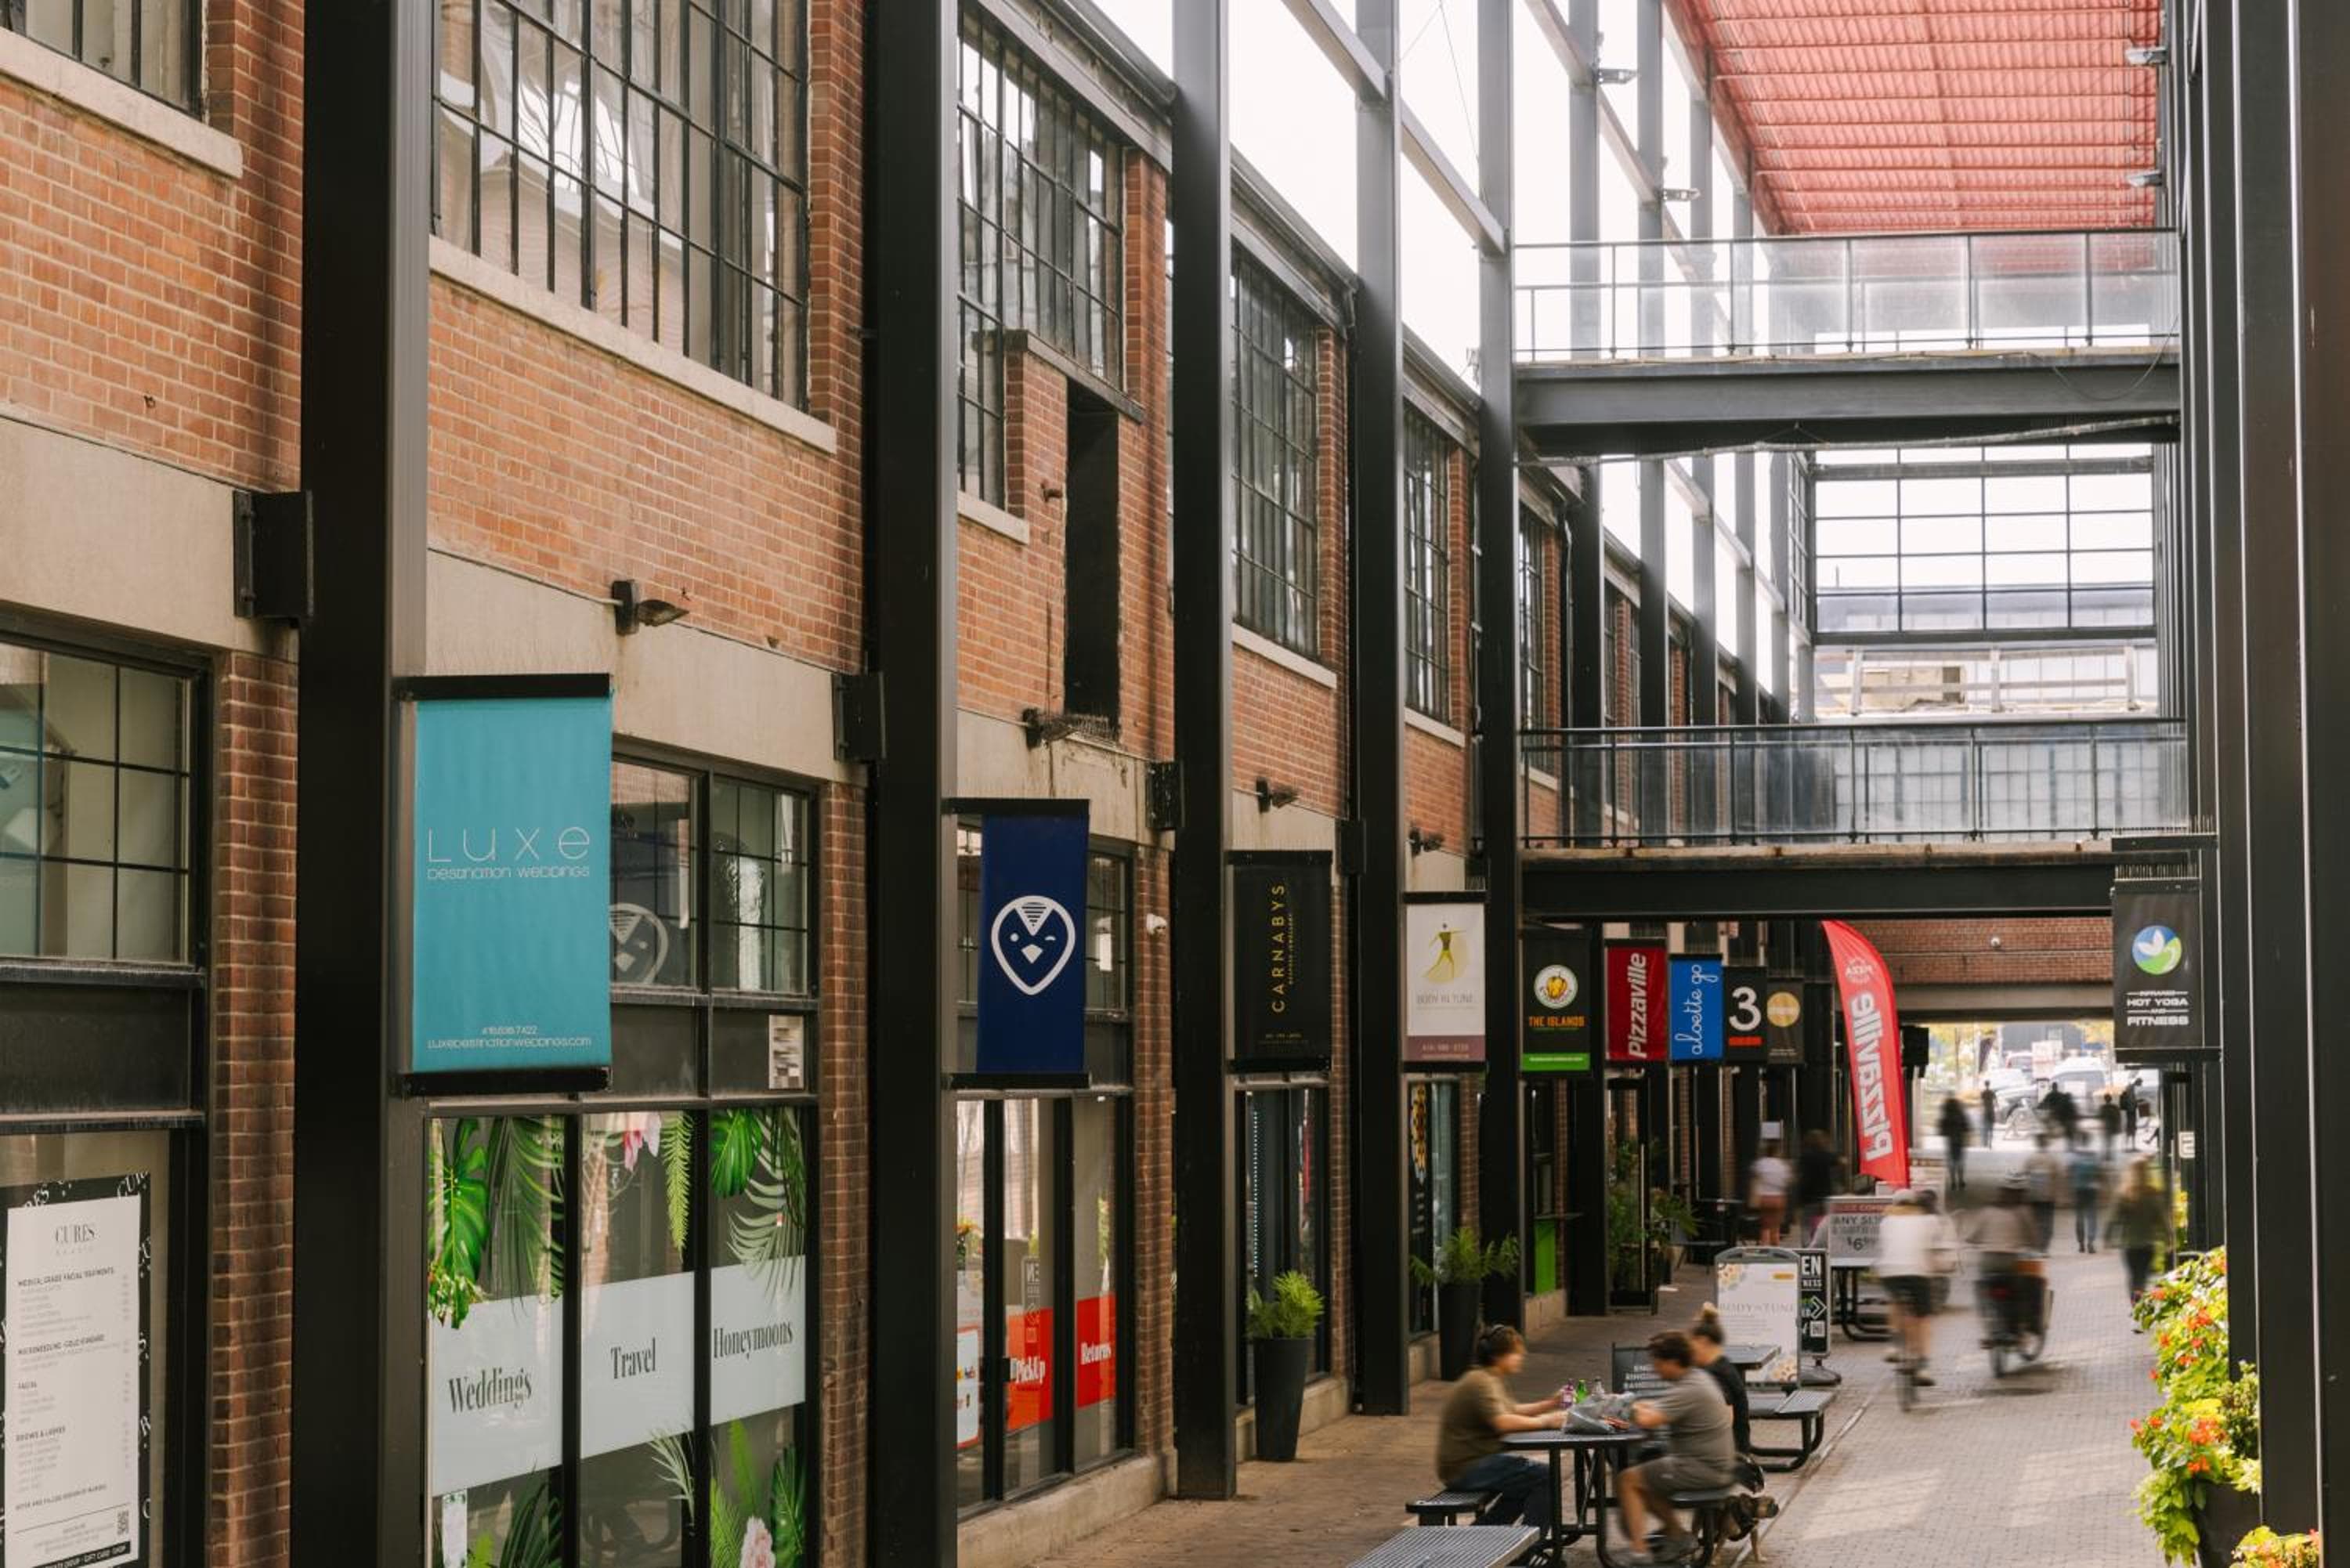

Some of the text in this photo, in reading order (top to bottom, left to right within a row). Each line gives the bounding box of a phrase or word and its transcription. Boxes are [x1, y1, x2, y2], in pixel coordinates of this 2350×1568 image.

[1271, 885, 1285, 1013] CARNABYS
[1628, 953, 1647, 1058] Pizzaville
[1729, 986, 1762, 1031] 3
[2127, 998, 2189, 1006] HOT YOGA
[2127, 1015, 2189, 1027] FITNESS
[1802, 1255, 1821, 1276] EN
[610, 1337, 656, 1380] Travel
[712, 1321, 794, 1360] Honeymoons
[449, 1367, 532, 1414] Weddings
